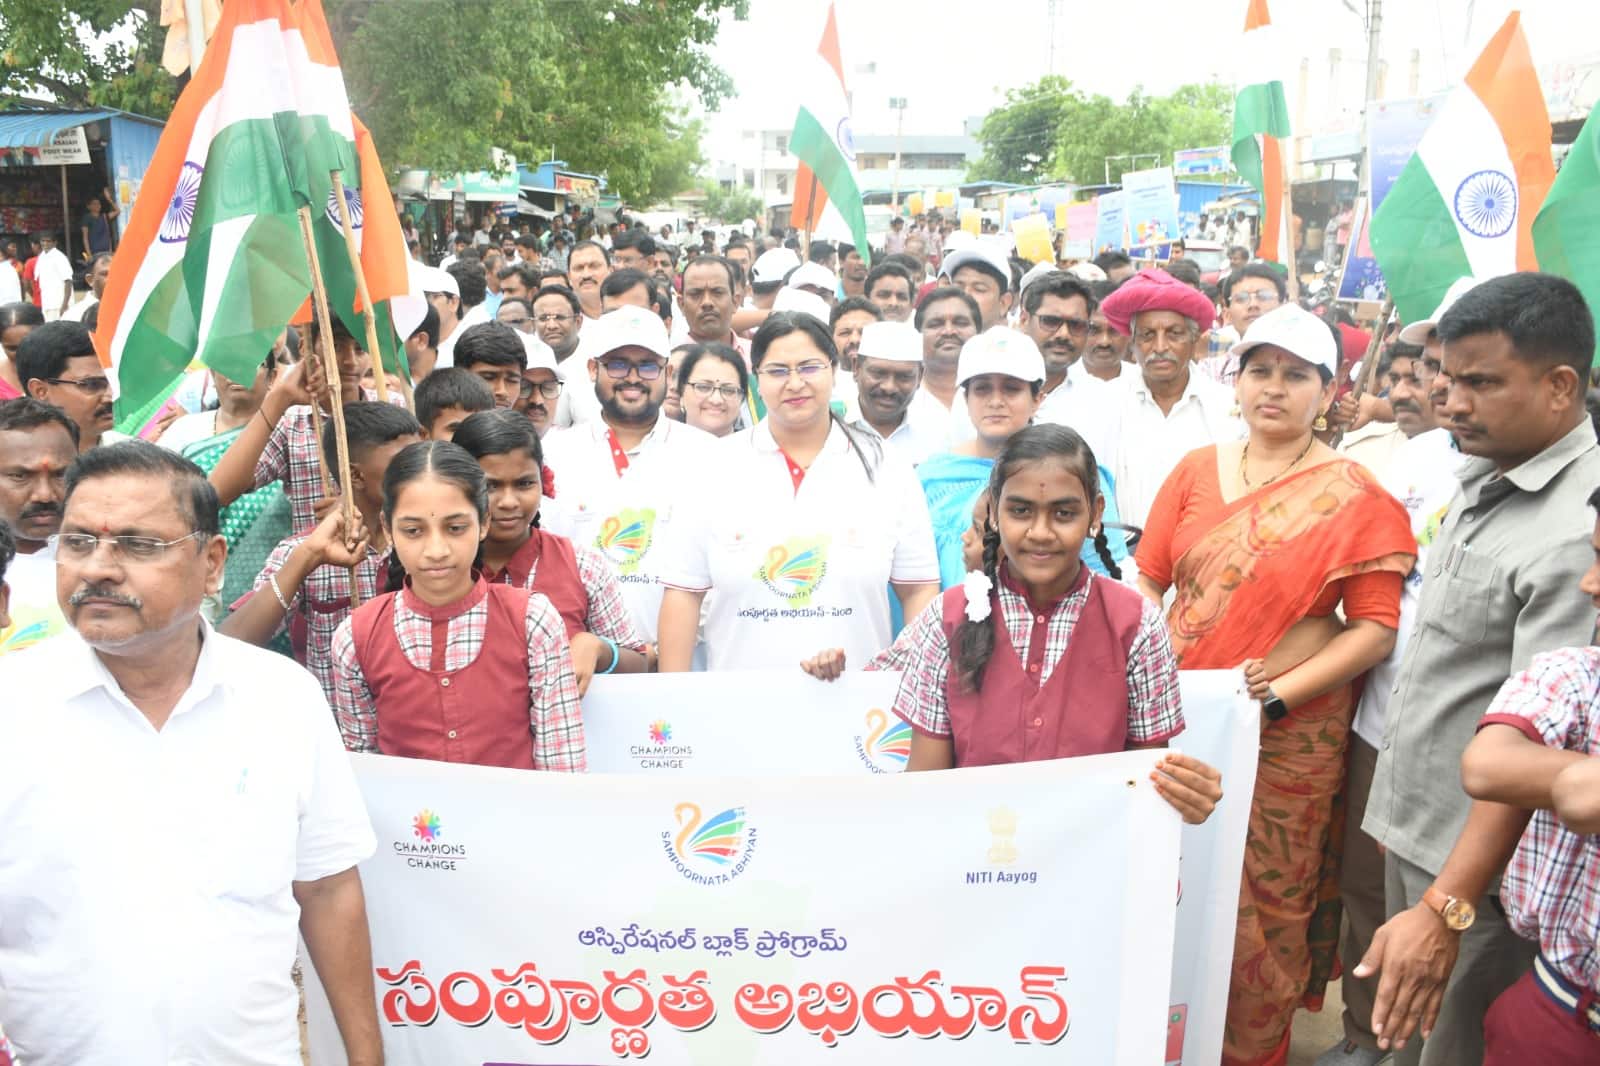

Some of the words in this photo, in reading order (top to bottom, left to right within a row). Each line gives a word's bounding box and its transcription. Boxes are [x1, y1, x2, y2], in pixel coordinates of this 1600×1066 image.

[630, 745, 693, 755] CHAMPIONS
[640, 759, 685, 769] CHANGE
[393, 841, 466, 855] CHAMPIONS
[661, 831, 730, 885] SAMPOORNATA
[731, 827, 757, 879] ABHIYAN
[407, 858, 457, 871] CHANGE
[966, 871, 992, 884] NITI
[996, 870, 1037, 885] Aayog
[578, 923, 697, 955] ఆస్పిరేషనల్
[703, 928, 750, 957] బ్లాక్
[755, 928, 848, 958] ప్రోగ్రామ్
[375, 959, 717, 1059] సంపూర్ణత
[733, 965, 1071, 1048] అభియాన్
